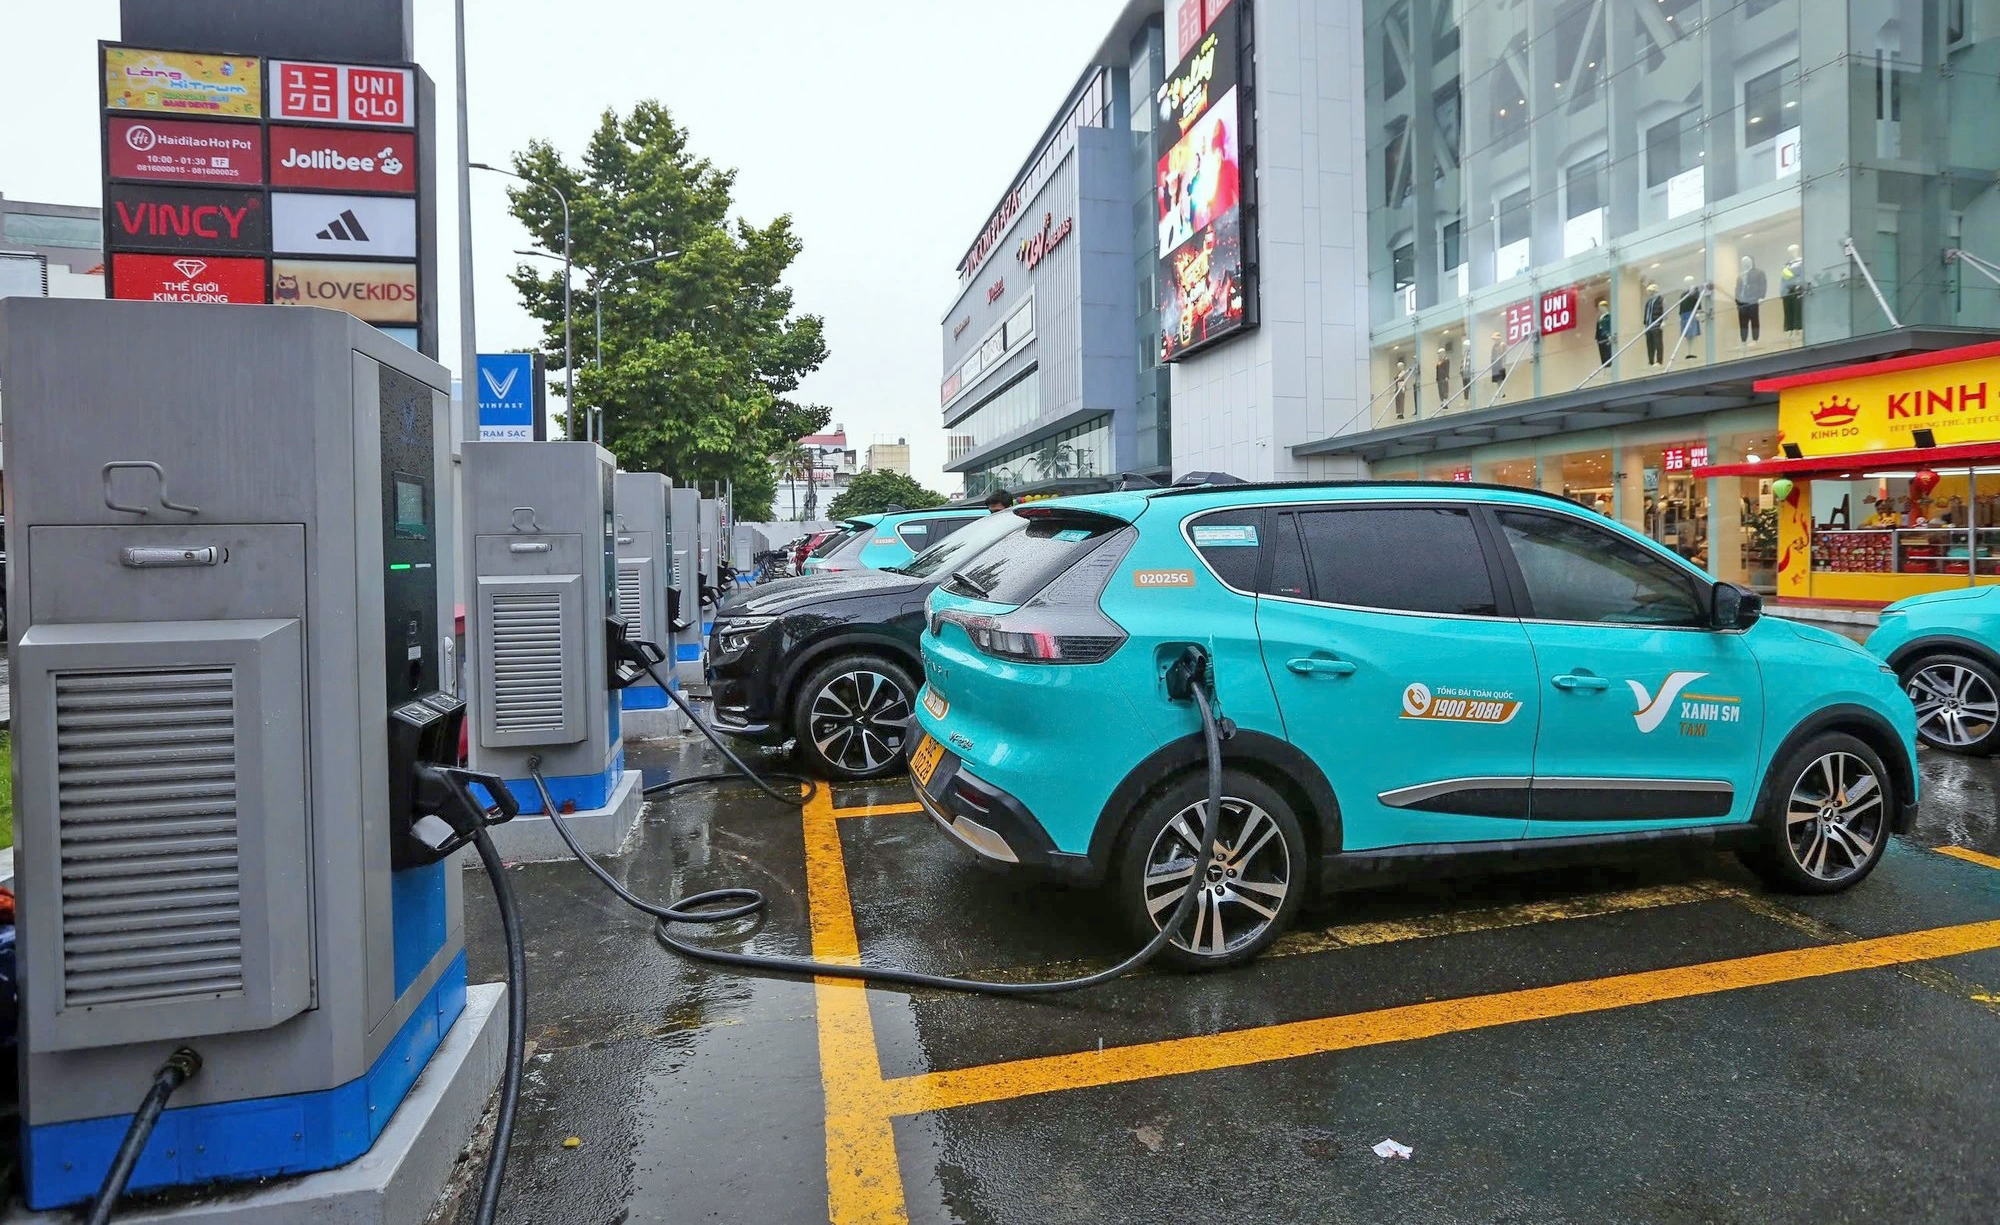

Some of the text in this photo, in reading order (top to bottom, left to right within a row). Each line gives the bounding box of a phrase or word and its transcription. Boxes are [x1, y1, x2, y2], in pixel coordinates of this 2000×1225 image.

[288, 70, 331, 91] ユニ
[353, 75, 394, 96] UNI
[287, 92, 331, 113] クロ
[354, 97, 398, 118] QLO
[157, 134, 252, 151] Haidilao Hot Pot
[146, 154, 174, 165] 10:00
[180, 156, 207, 166] 01:30
[214, 157, 226, 168] 1F
[280, 147, 375, 173] Jollibee
[114, 199, 248, 240] VINCY
[162, 279, 190, 292] THẾ
[306, 280, 416, 302] LOVEKIDS
[153, 292, 178, 303] KIM
[1543, 293, 1567, 314] UNI
[1543, 310, 1570, 332] QLO
[1888, 382, 1986, 419] KINH
[1811, 429, 1838, 440] KINH
[1690, 447, 1708, 458] UNI
[1139, 572, 1188, 585] 02025G
[1458, 687, 1471, 697] ĐÀI
[1472, 688, 1492, 698] TOÀN
[1431, 698, 1504, 720] 1900 2088
[1680, 701, 1740, 723] XANH SM
[1680, 721, 1707, 737] TAXI
